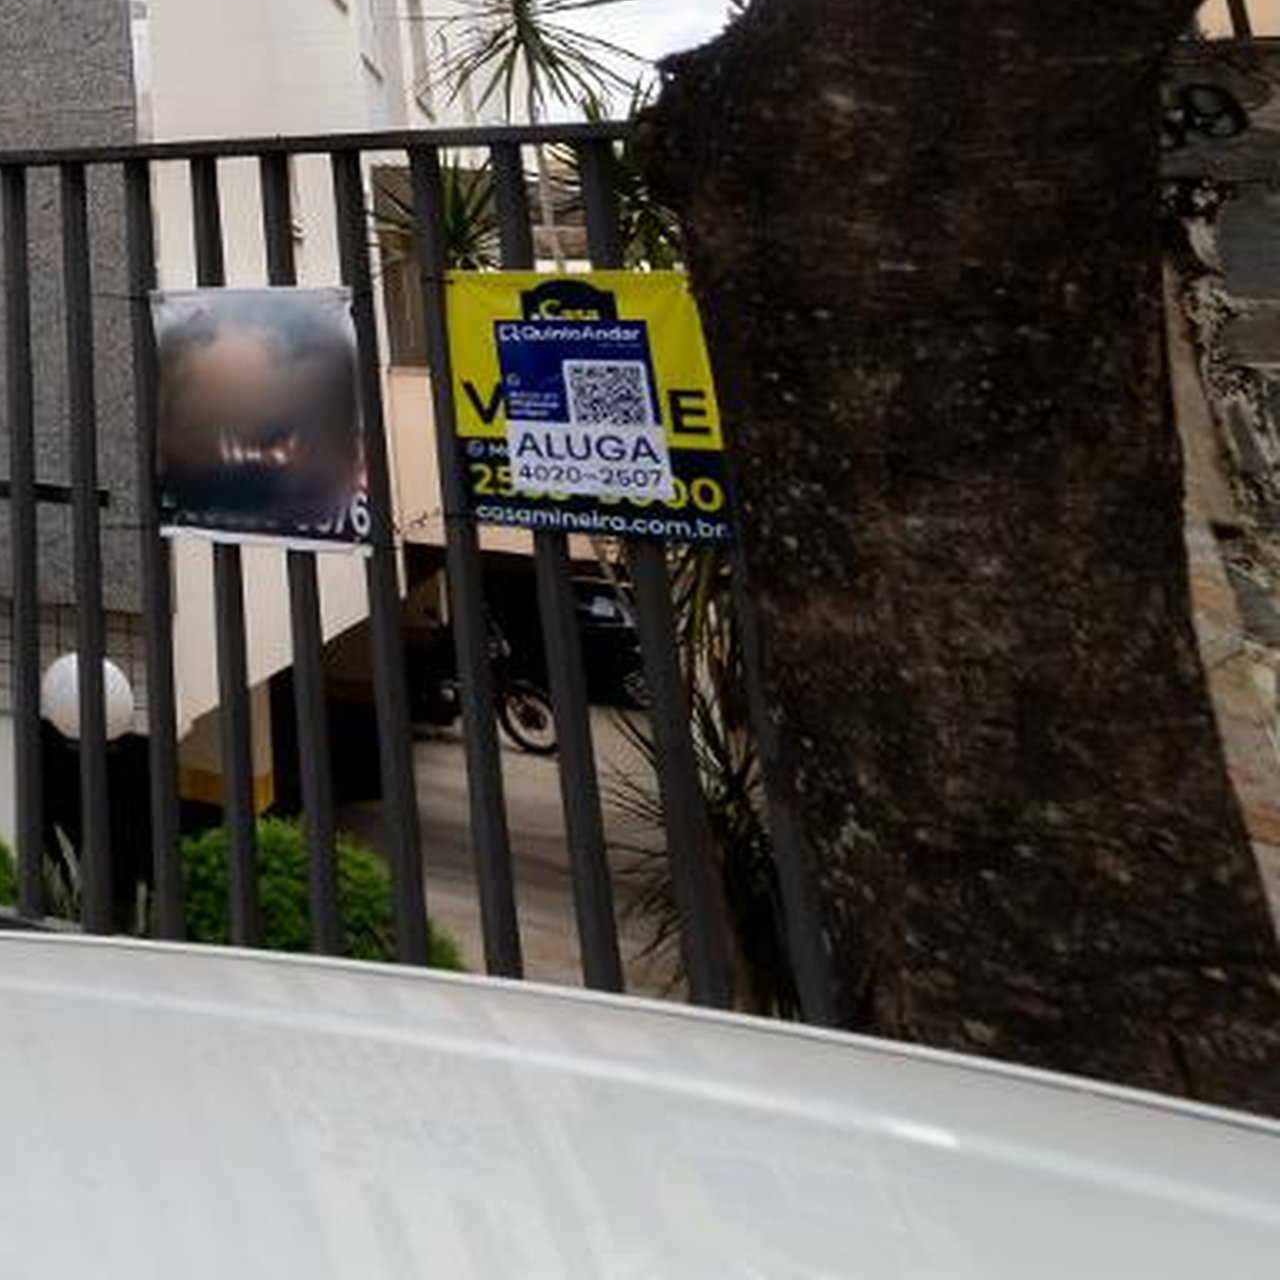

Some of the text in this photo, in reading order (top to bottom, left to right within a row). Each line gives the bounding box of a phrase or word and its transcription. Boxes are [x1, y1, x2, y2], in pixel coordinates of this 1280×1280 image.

[520, 323, 641, 342] QuintoAndar
[516, 431, 662, 464] ALUGA
[518, 464, 664, 489] 4020-2507
[475, 502, 728, 539] casamineiro.com.br
